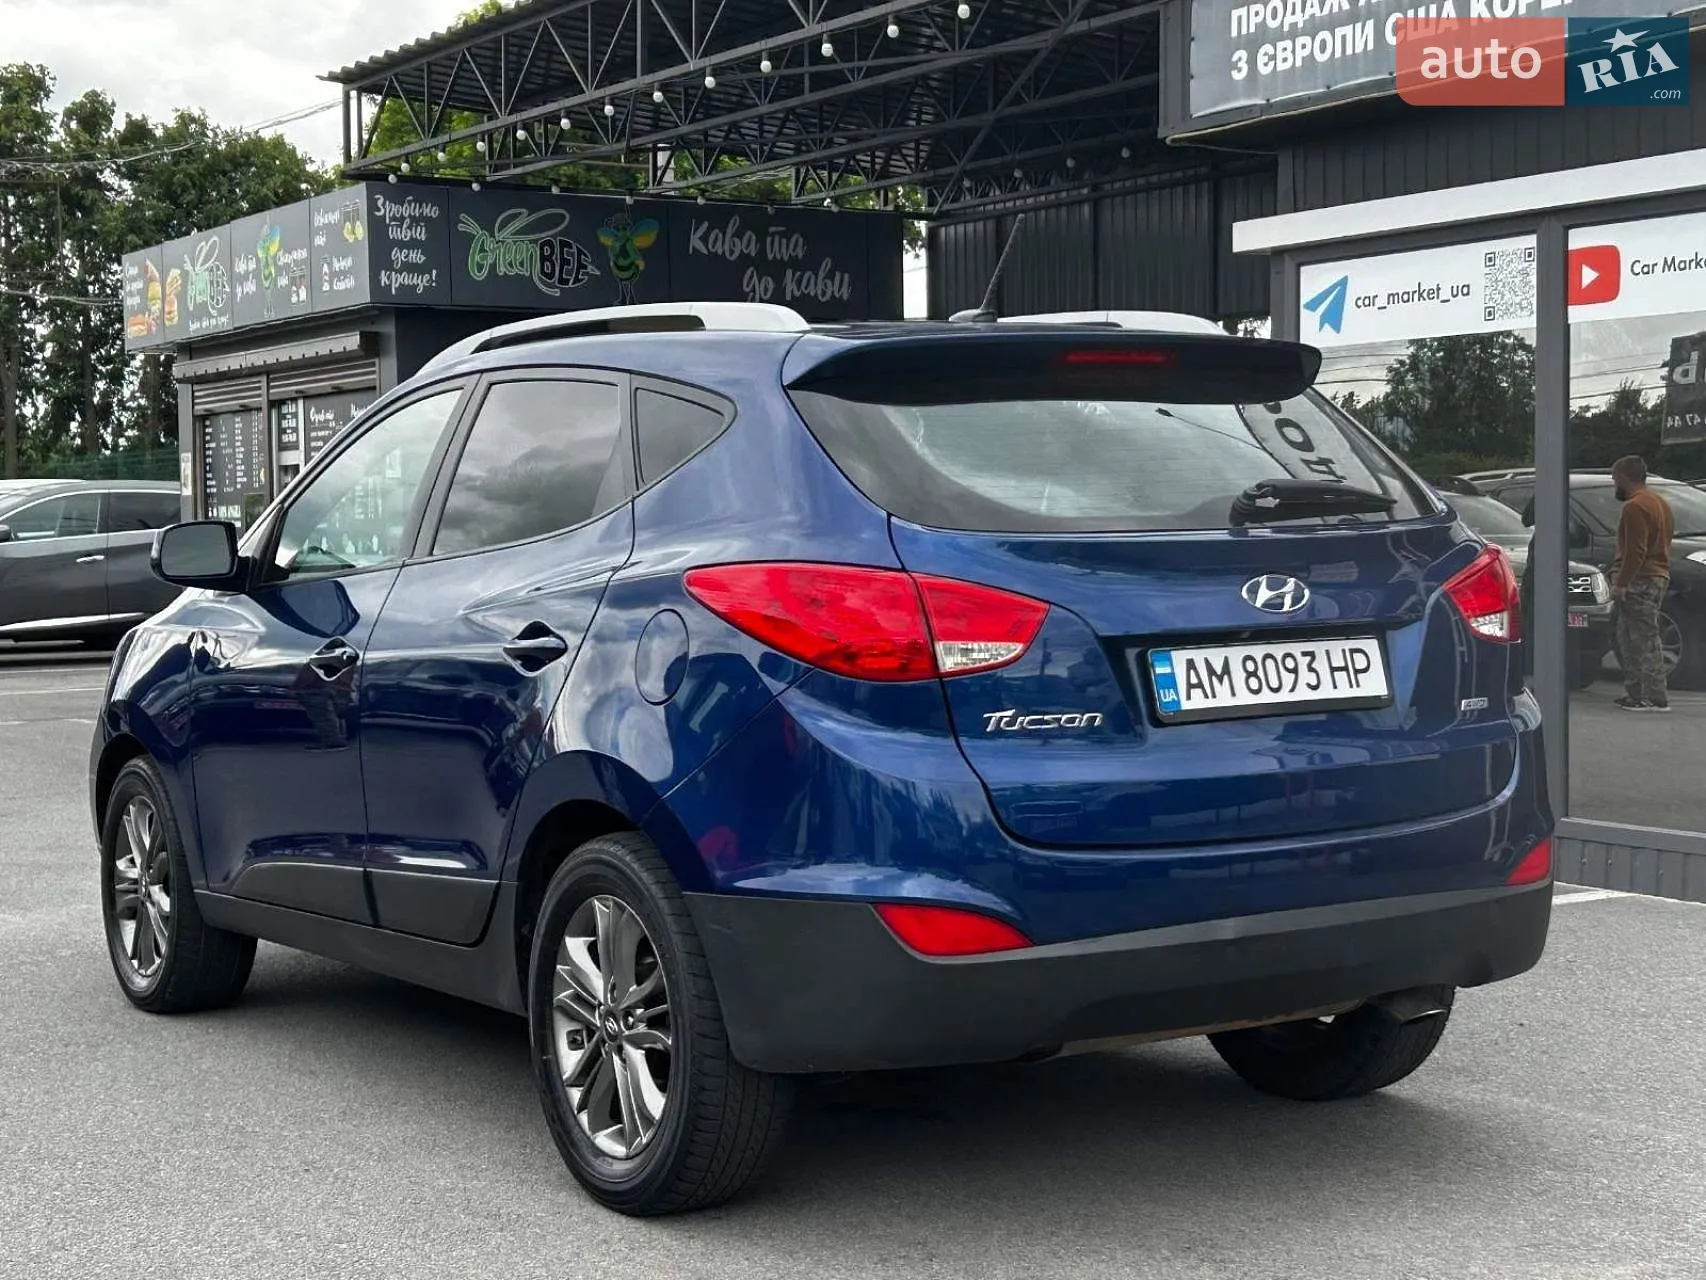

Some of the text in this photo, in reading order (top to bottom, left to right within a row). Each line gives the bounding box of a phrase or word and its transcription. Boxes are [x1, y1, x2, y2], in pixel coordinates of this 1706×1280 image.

[1231, 50, 1249, 81] З
[1256, 18, 1375, 76] ЄВРОПИ
[1384, 0, 1460, 46] США
[374, 195, 439, 224] Зробимо
[388, 219, 427, 241] твій
[689, 214, 807, 261] Кава та
[391, 251, 426, 269] день
[1630, 259, 1658, 276] Car
[380, 269, 437, 294] краще!
[742, 257, 852, 303] до кави
[1354, 282, 1471, 310] car_market_ua
[1185, 647, 1371, 701] AM 8093 HP
[1160, 690, 1177, 702] UA
[983, 709, 1103, 732] Tucson
